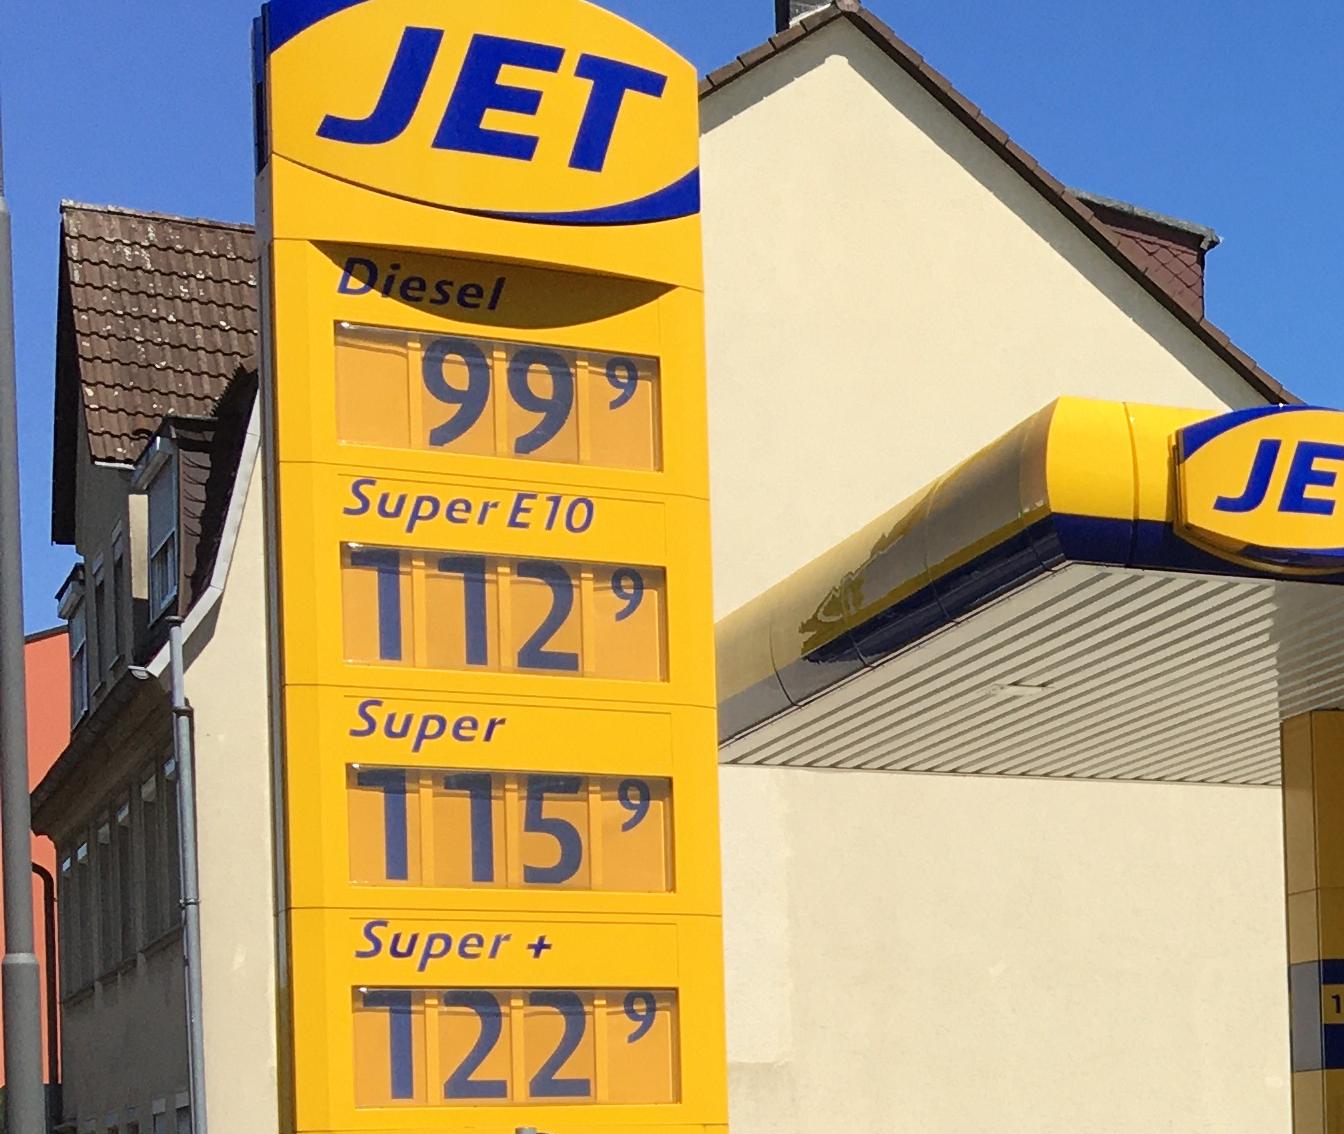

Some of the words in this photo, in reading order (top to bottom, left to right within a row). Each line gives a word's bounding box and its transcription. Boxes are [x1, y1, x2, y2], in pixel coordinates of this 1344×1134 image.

[315, 25, 668, 173] JET
[336, 255, 506, 311] Diesel
[342, 477, 500, 534] Super
[506, 491, 595, 534] E10
[348, 699, 507, 753] Super
[354, 919, 512, 973] Super
[1331, 994, 1341, 1014] 1
